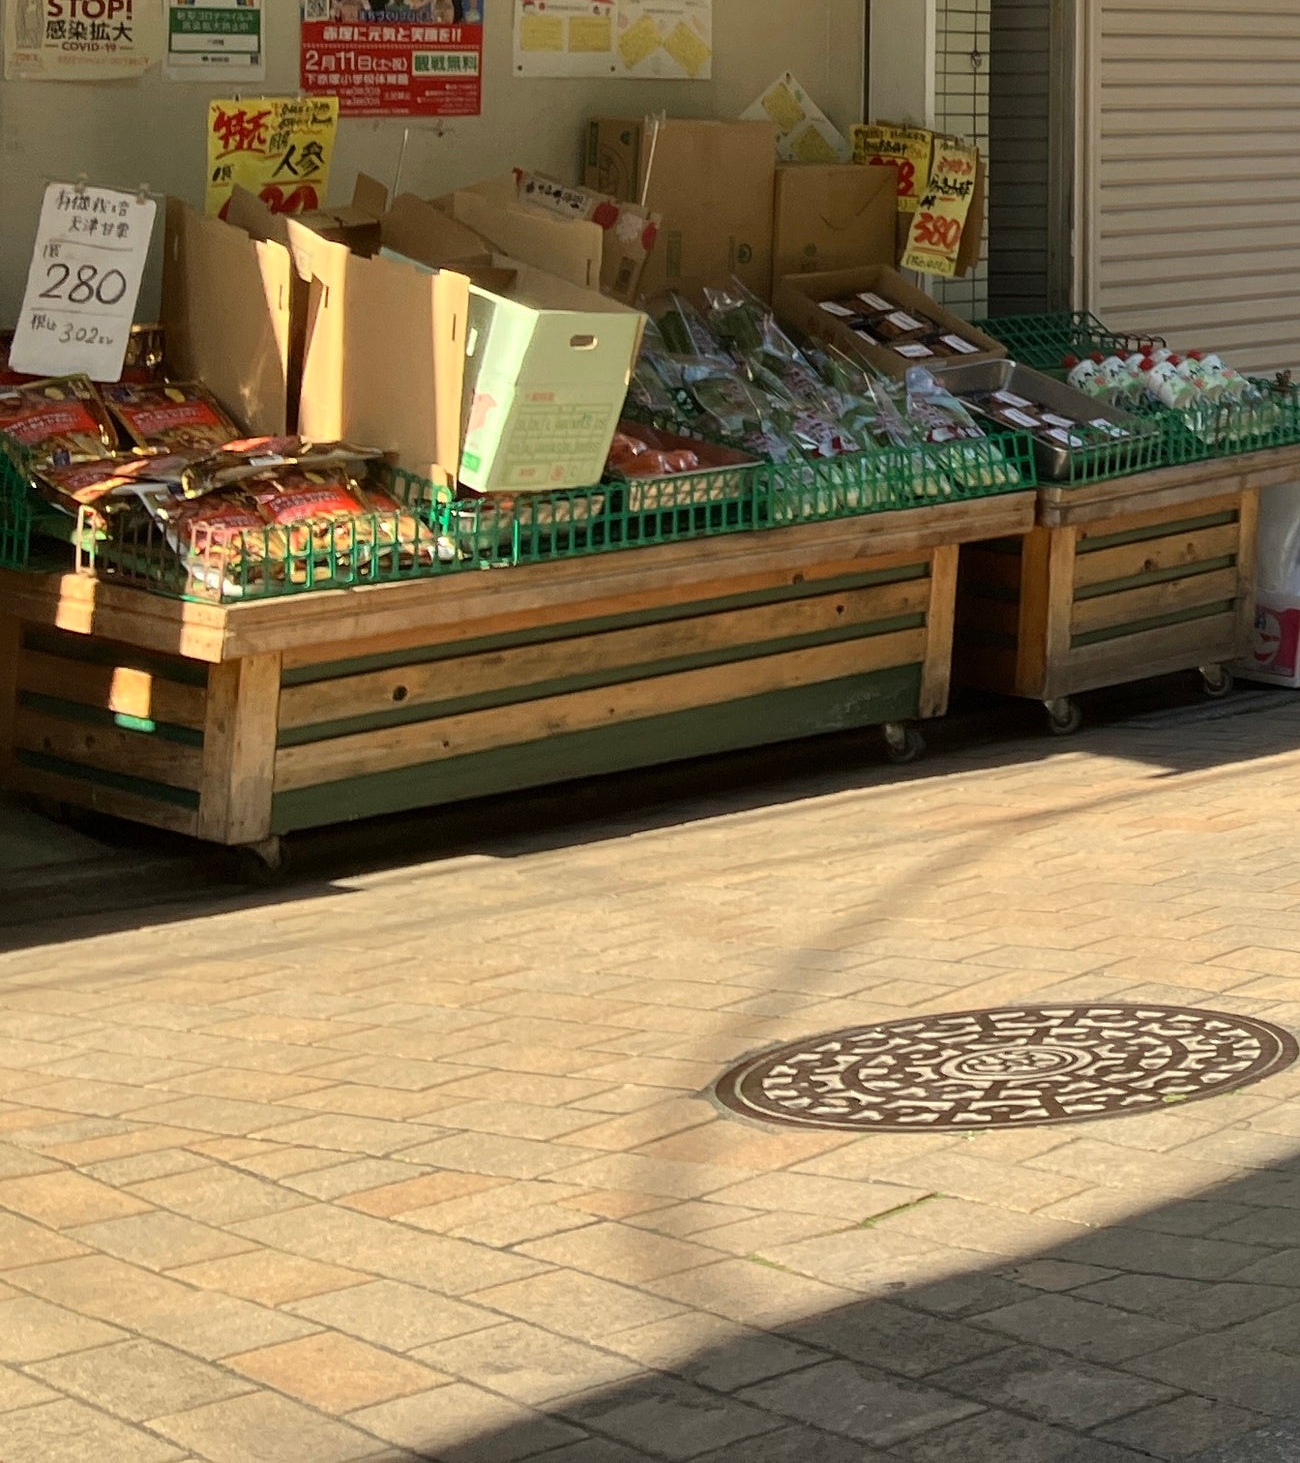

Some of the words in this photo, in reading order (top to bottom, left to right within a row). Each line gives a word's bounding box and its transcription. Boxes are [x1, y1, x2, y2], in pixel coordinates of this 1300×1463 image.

[46, 20, 133, 42] 感染拡大
[62, 41, 117, 53] COVID-19
[39, 263, 127, 305] 280
